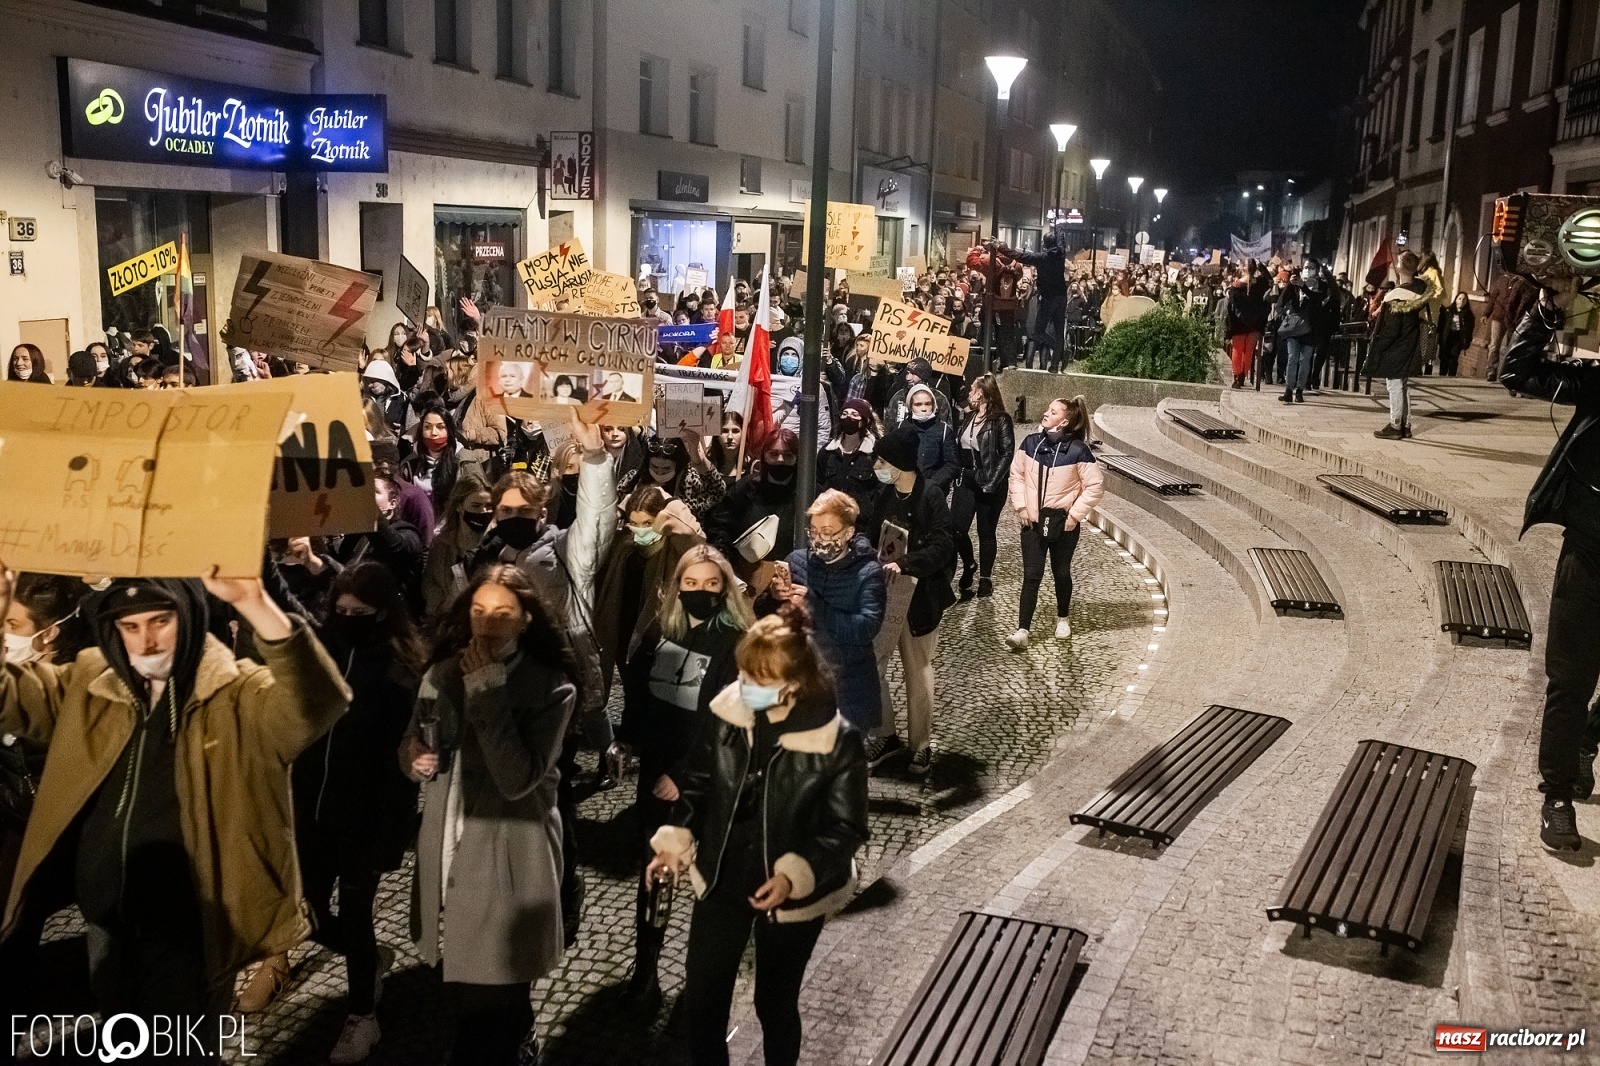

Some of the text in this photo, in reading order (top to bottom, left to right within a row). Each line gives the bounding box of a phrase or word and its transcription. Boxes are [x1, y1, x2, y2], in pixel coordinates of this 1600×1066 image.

[144, 87, 291, 148] Jubiler Złotnik
[309, 107, 368, 136] Jubiler
[165, 137, 215, 155] OCZADŁY
[310, 137, 371, 163] Złotnik
[17, 221, 35, 237] 36
[12, 259, 23, 270] 36
[475, 245, 505, 258] PRZECENA
[524, 251, 560, 278] MOJA
[567, 253, 588, 273] NIE
[111, 246, 177, 292] ZŁOTO -10%
[523, 268, 570, 296] PUSIA
[879, 302, 906, 327] PiS
[481, 313, 659, 359] WITAMY W CYRKU
[493, 344, 505, 358] W
[514, 343, 569, 363] ROLACH
[47, 396, 252, 432] IMPOSTOR
[270, 419, 366, 493] NA
